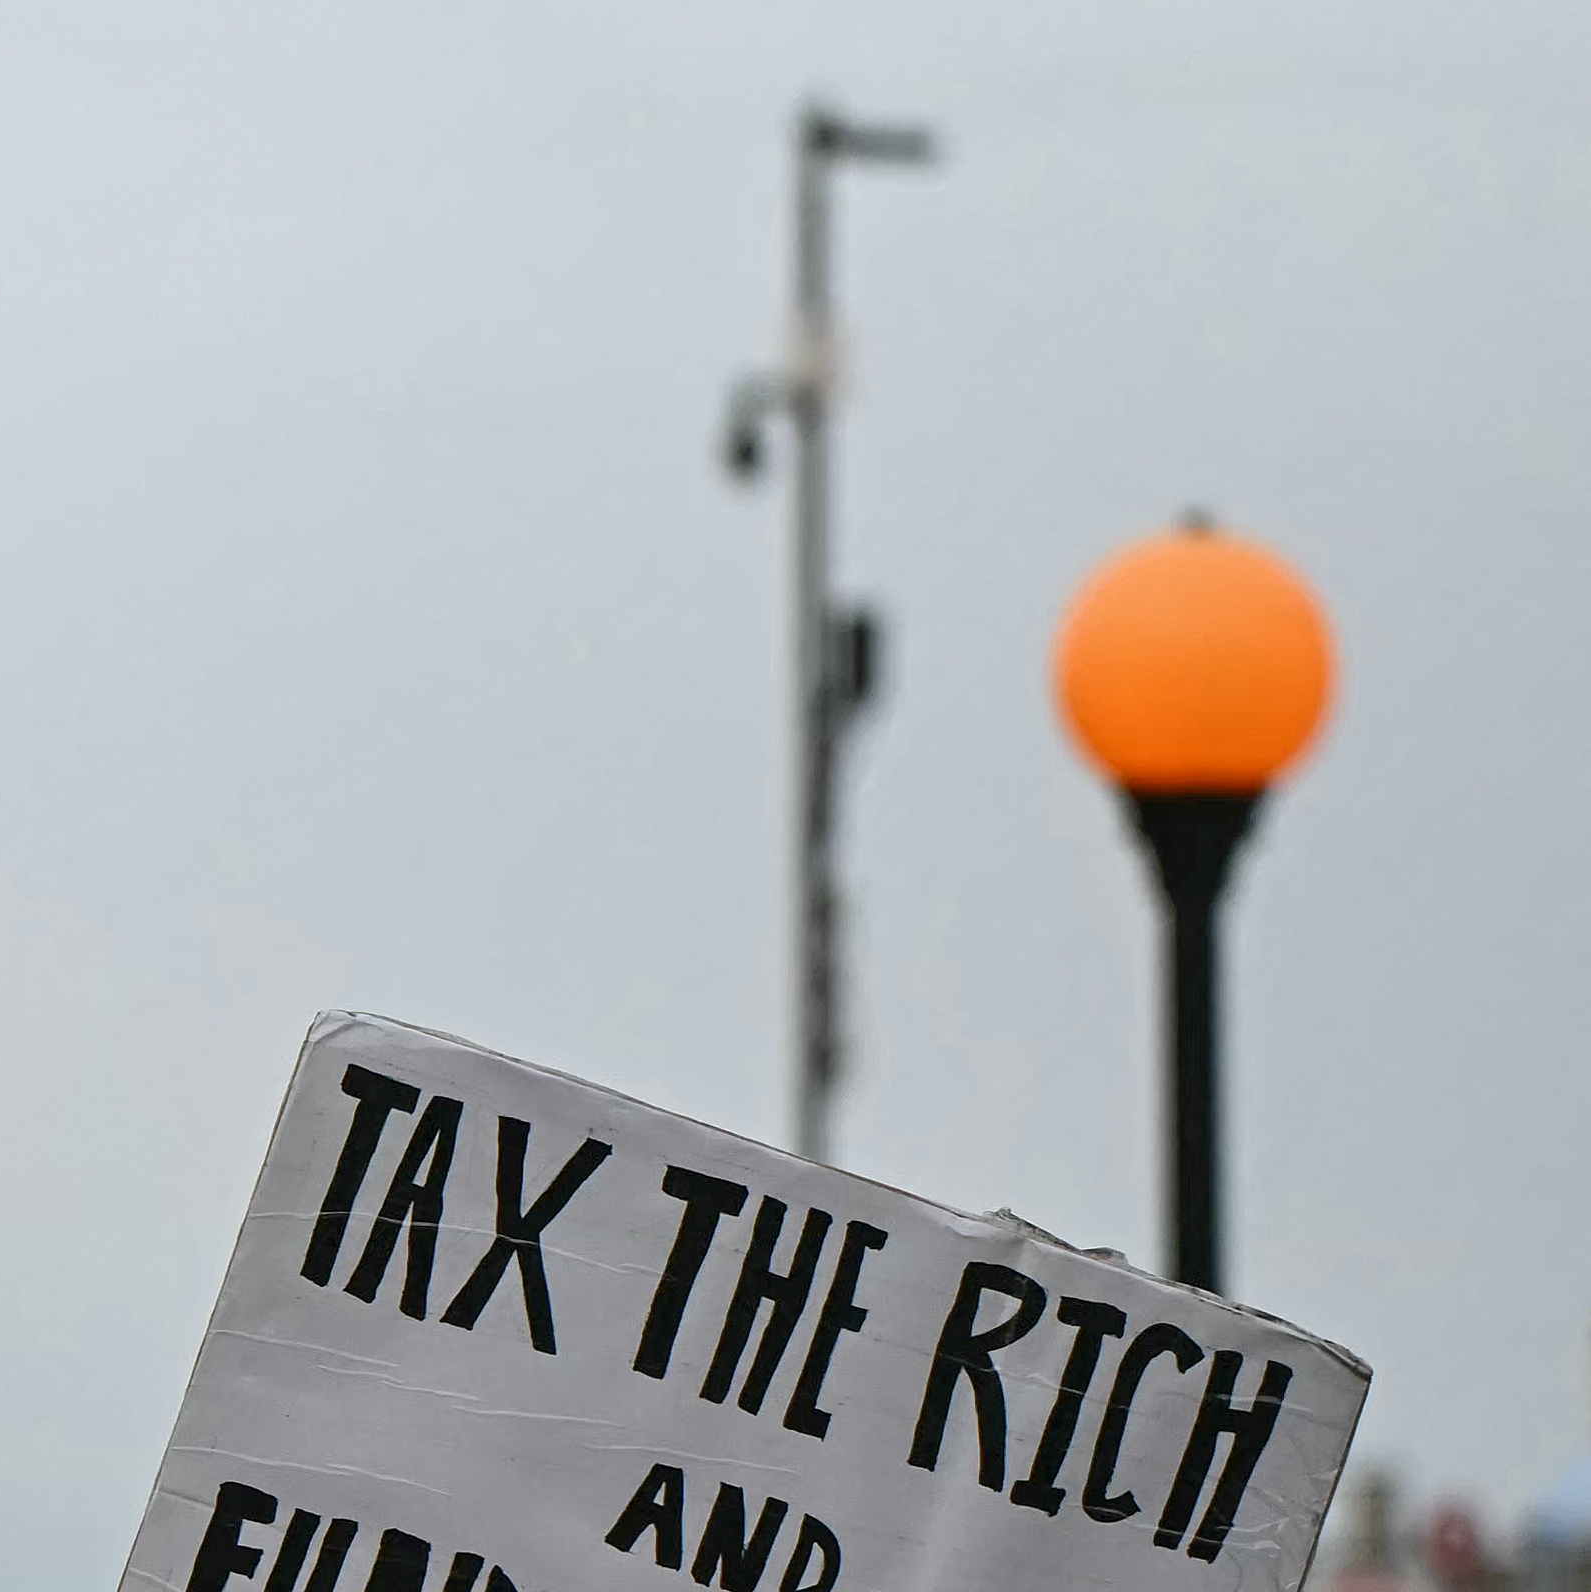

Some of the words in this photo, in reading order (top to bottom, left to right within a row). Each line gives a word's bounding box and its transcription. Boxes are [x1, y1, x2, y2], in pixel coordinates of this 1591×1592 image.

[300, 1064, 612, 1355] TAX
[633, 1165, 888, 1441] THE
[907, 1262, 1293, 1564] RICH
